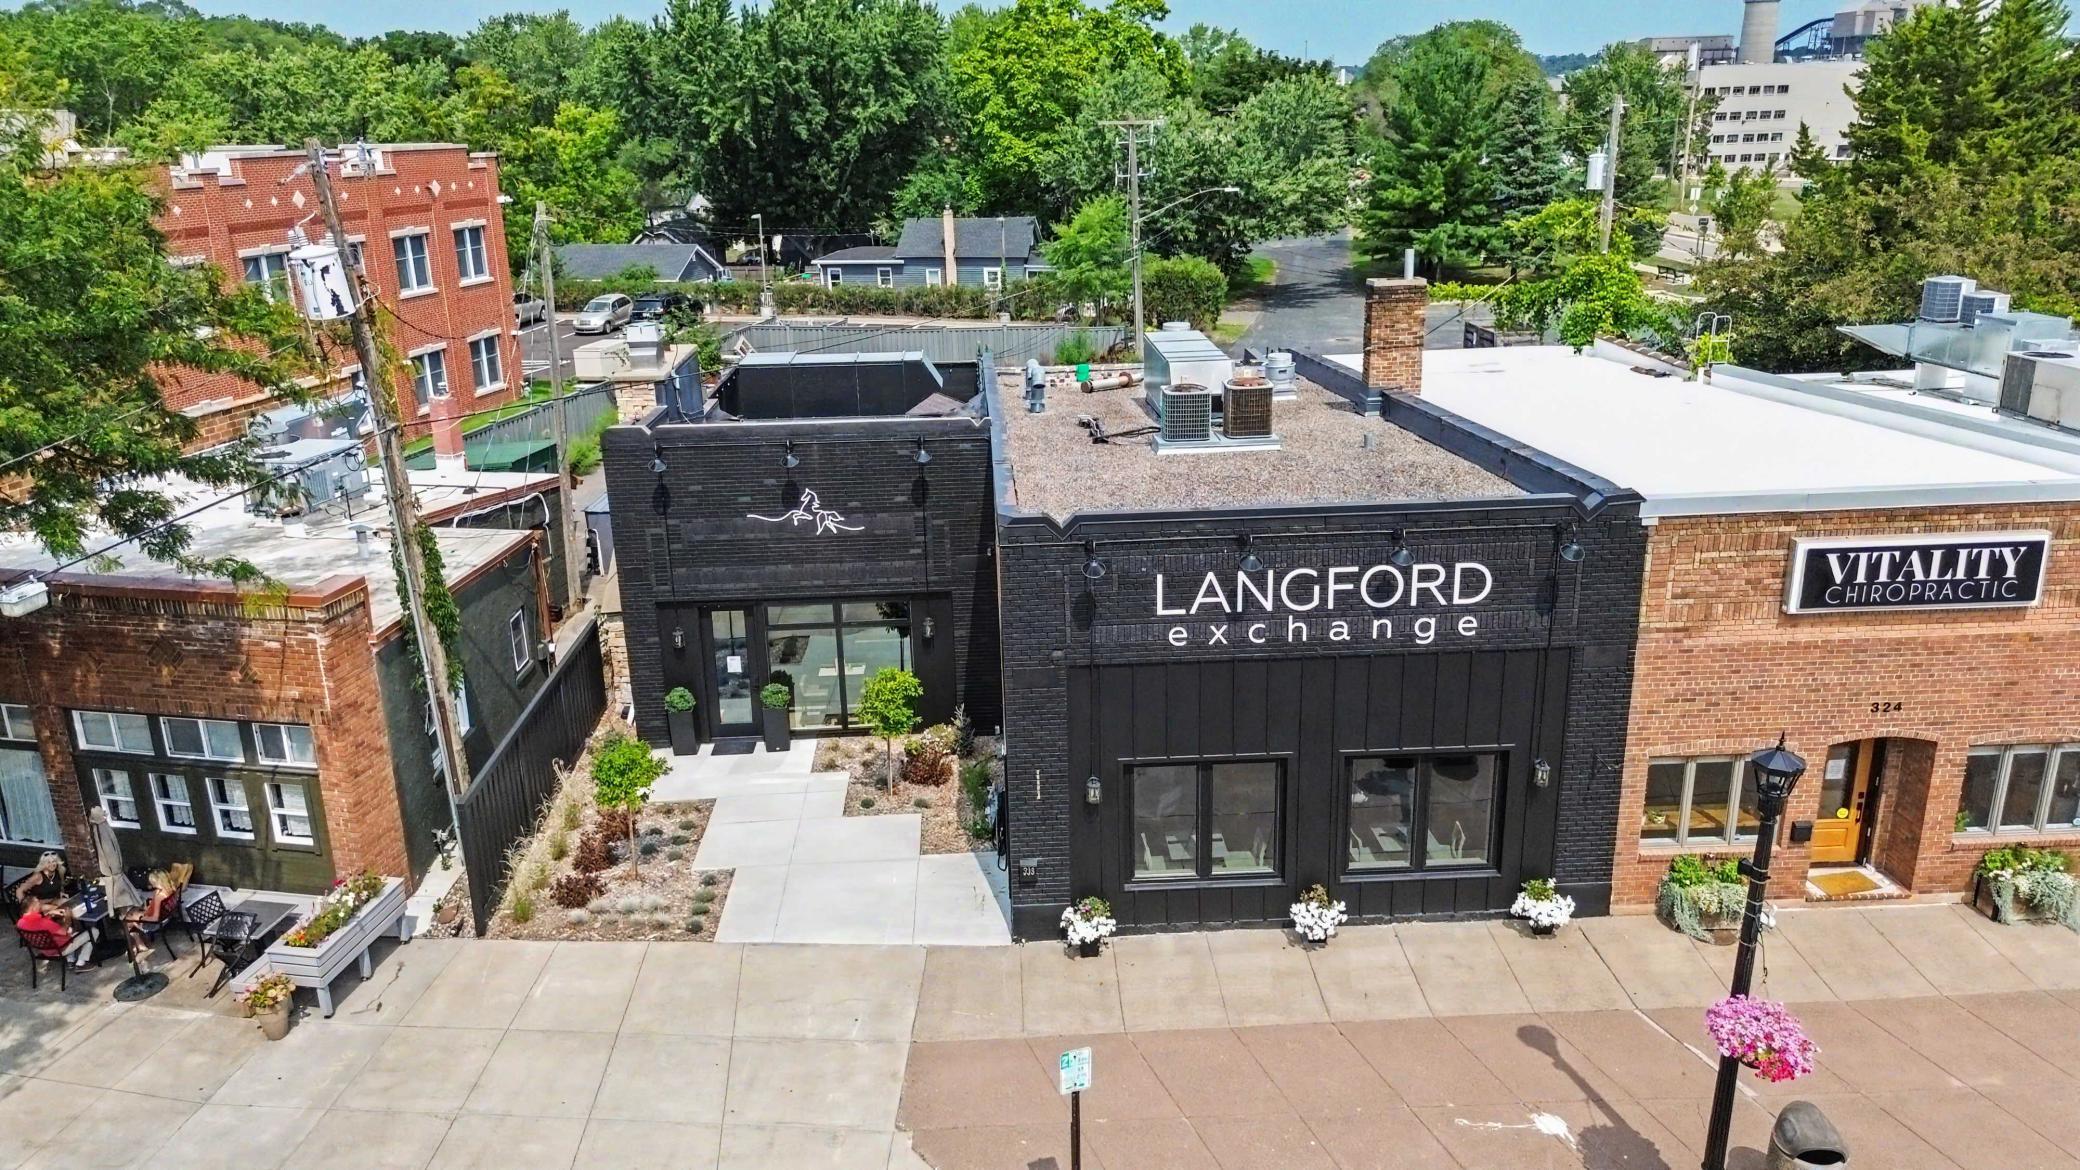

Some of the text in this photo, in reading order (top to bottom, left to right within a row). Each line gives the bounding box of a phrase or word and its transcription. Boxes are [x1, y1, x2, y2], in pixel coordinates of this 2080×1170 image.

[1825, 546, 2028, 584] VITALITY
[1156, 562, 1493, 616] LANGFORD
[1825, 579, 2019, 604] CHIROPRACTIC
[1168, 615, 1478, 647] exchange
[1870, 702, 1903, 714] 324
